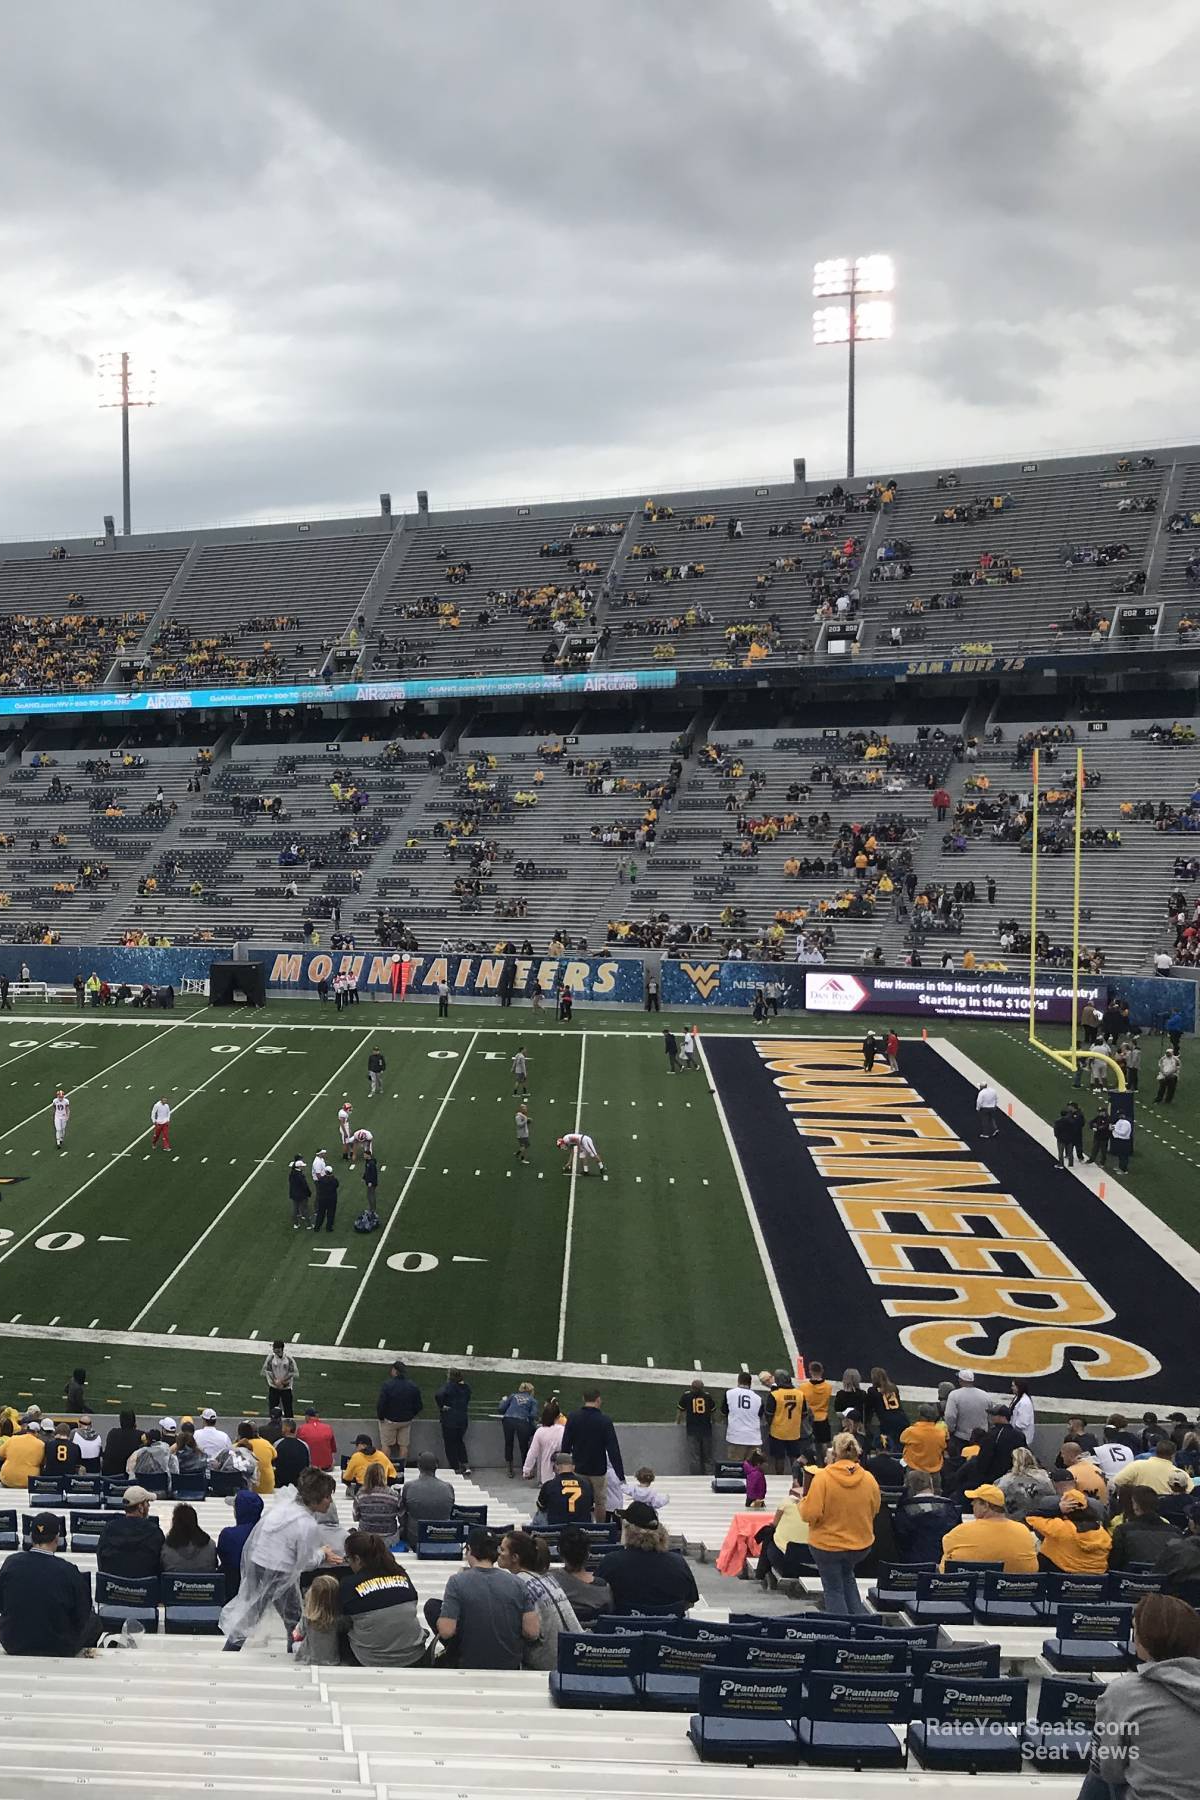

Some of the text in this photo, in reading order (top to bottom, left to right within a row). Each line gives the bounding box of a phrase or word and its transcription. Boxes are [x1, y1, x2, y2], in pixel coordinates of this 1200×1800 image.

[907, 658, 1025, 674] SAM HUFF 75
[584, 679, 607, 692] AIR
[356, 687, 376, 700] AIR
[146, 696, 166, 710] AIR
[270, 953, 619, 992] MOUNTAINEERS
[874, 979, 893, 990] New
[894, 980, 925, 991] Homes
[926, 981, 936, 991] in
[938, 981, 953, 992] the
[954, 982, 980, 993] Heart
[982, 982, 992, 993] of
[919, 994, 967, 1010] Starting
[968, 997, 978, 1007] in
[981, 997, 1003, 1008] the
[427, 1050, 519, 1060] 10
[752, 1041, 1162, 1382] MOUNTAINEERS
[308, 1247, 439, 1273] 10
[692, 1398, 705, 1414] 18
[738, 1394, 750, 1410] 16
[784, 1402, 796, 1419] 7
[56, 1445, 66, 1462] 8
[1109, 1448, 1124, 1462] 15
[562, 1486, 582, 1512] 7
[356, 1576, 409, 1598] MOUNTAINEERS
[586, 1646, 631, 1654] Panhandle
[672, 1649, 717, 1660] Panhandle
[759, 1652, 806, 1660] Panhandle
[848, 1652, 894, 1661] Panhandle
[942, 1660, 988, 1670] Panhandle
[734, 1684, 788, 1693] Panhandle
[846, 1688, 900, 1698] Panhandle
[958, 1693, 1013, 1703] Panhandle
